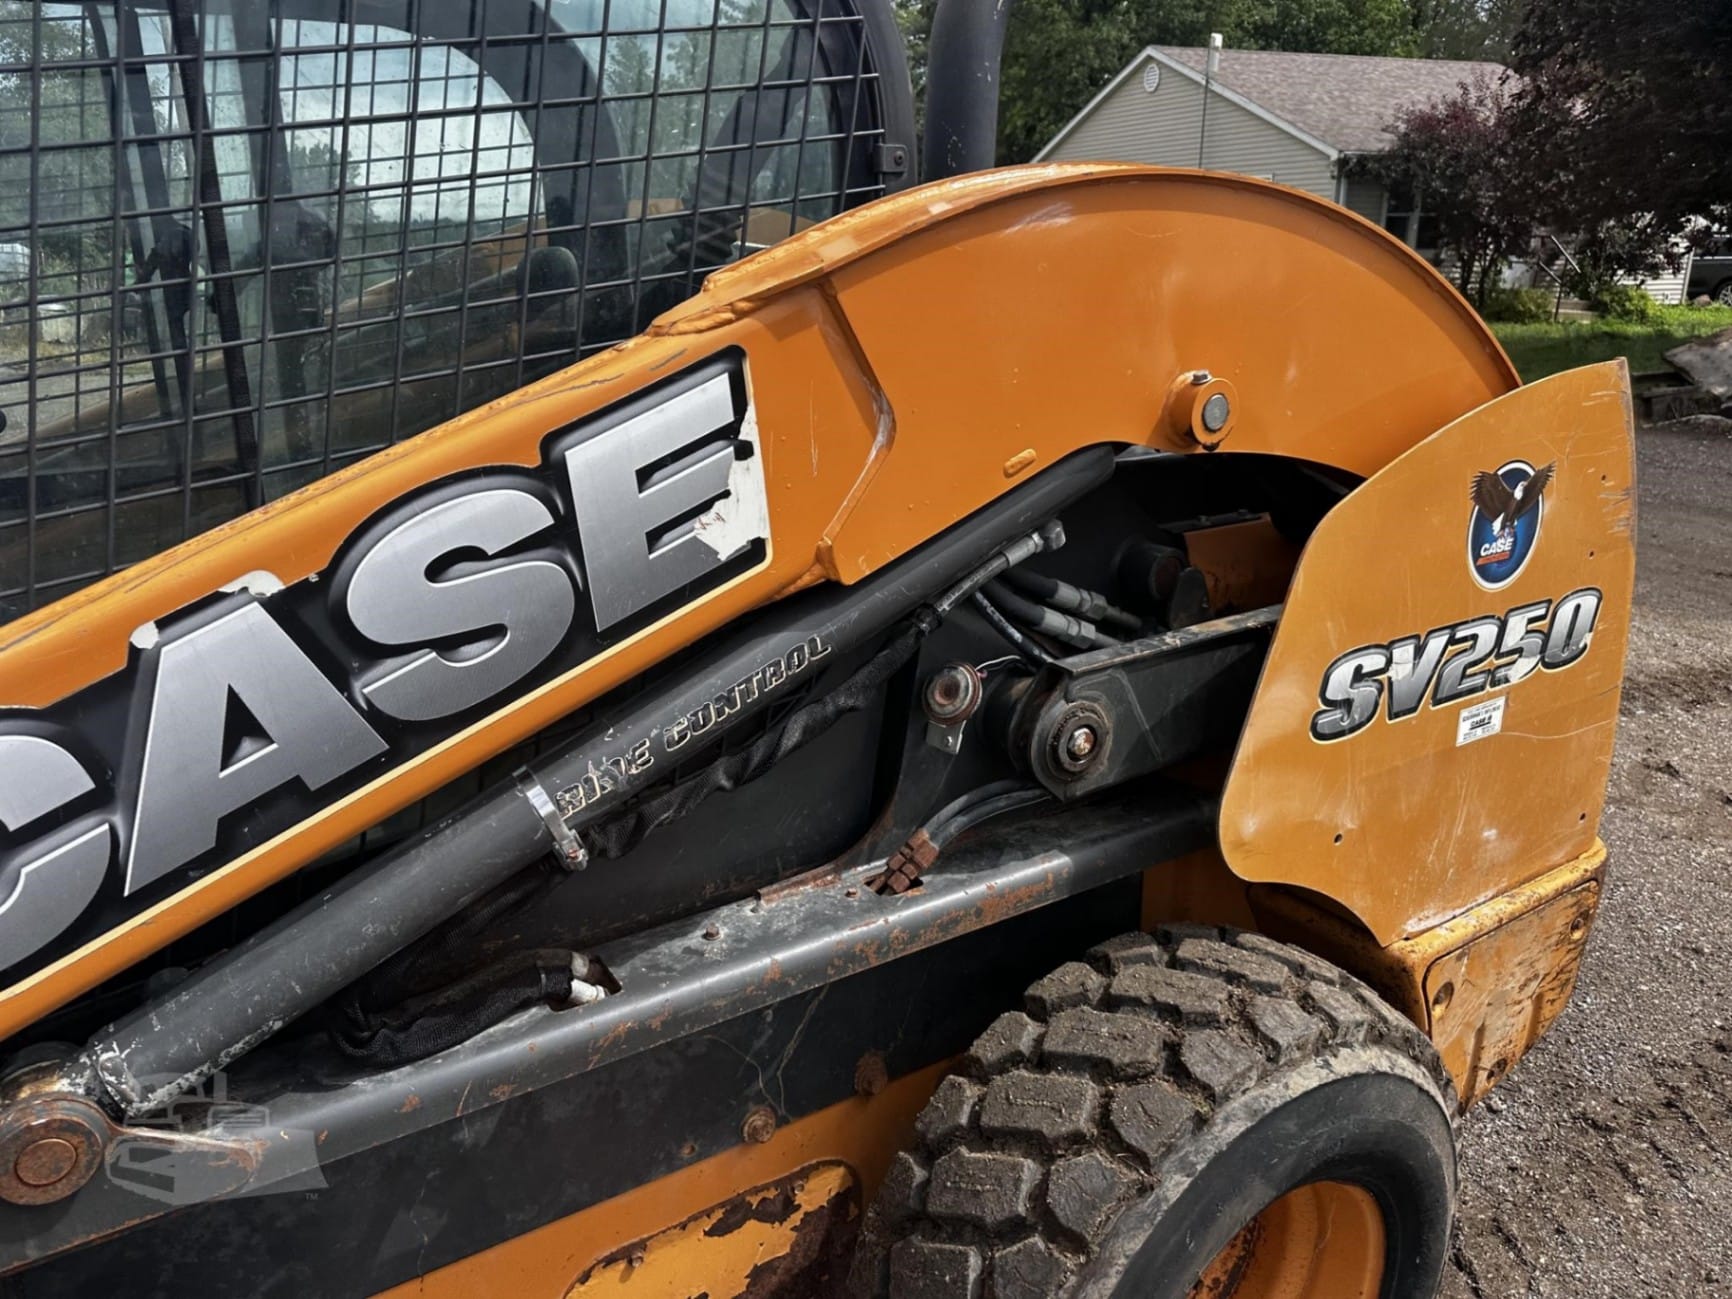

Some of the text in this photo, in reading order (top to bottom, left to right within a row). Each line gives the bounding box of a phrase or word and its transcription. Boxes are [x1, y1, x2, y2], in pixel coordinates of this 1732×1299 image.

[1480, 537, 1514, 556] CASE
[664, 633, 832, 752] CONTROL
[1310, 587, 1602, 742] SV250
